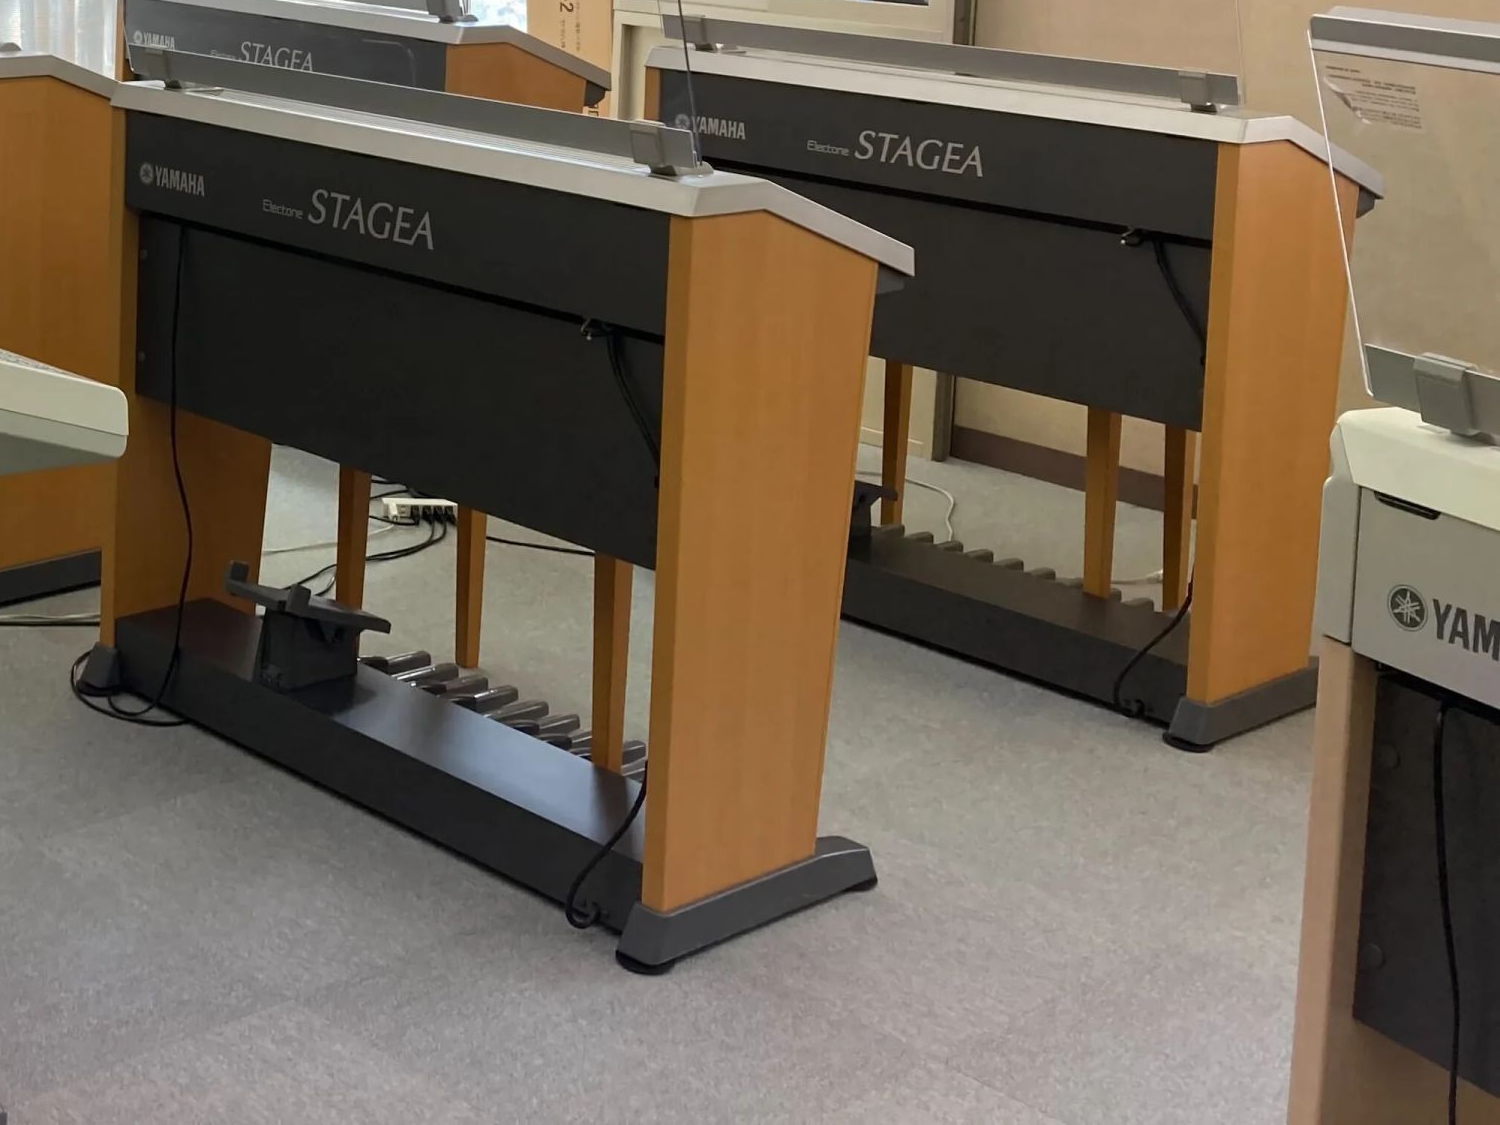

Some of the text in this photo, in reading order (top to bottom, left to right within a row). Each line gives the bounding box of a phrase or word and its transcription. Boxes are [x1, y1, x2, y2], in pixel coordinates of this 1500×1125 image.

[691, 115, 746, 141] YAMAHA
[853, 129, 984, 178] STAGEA
[154, 165, 435, 250] YAMAHA Electone STAGEA
